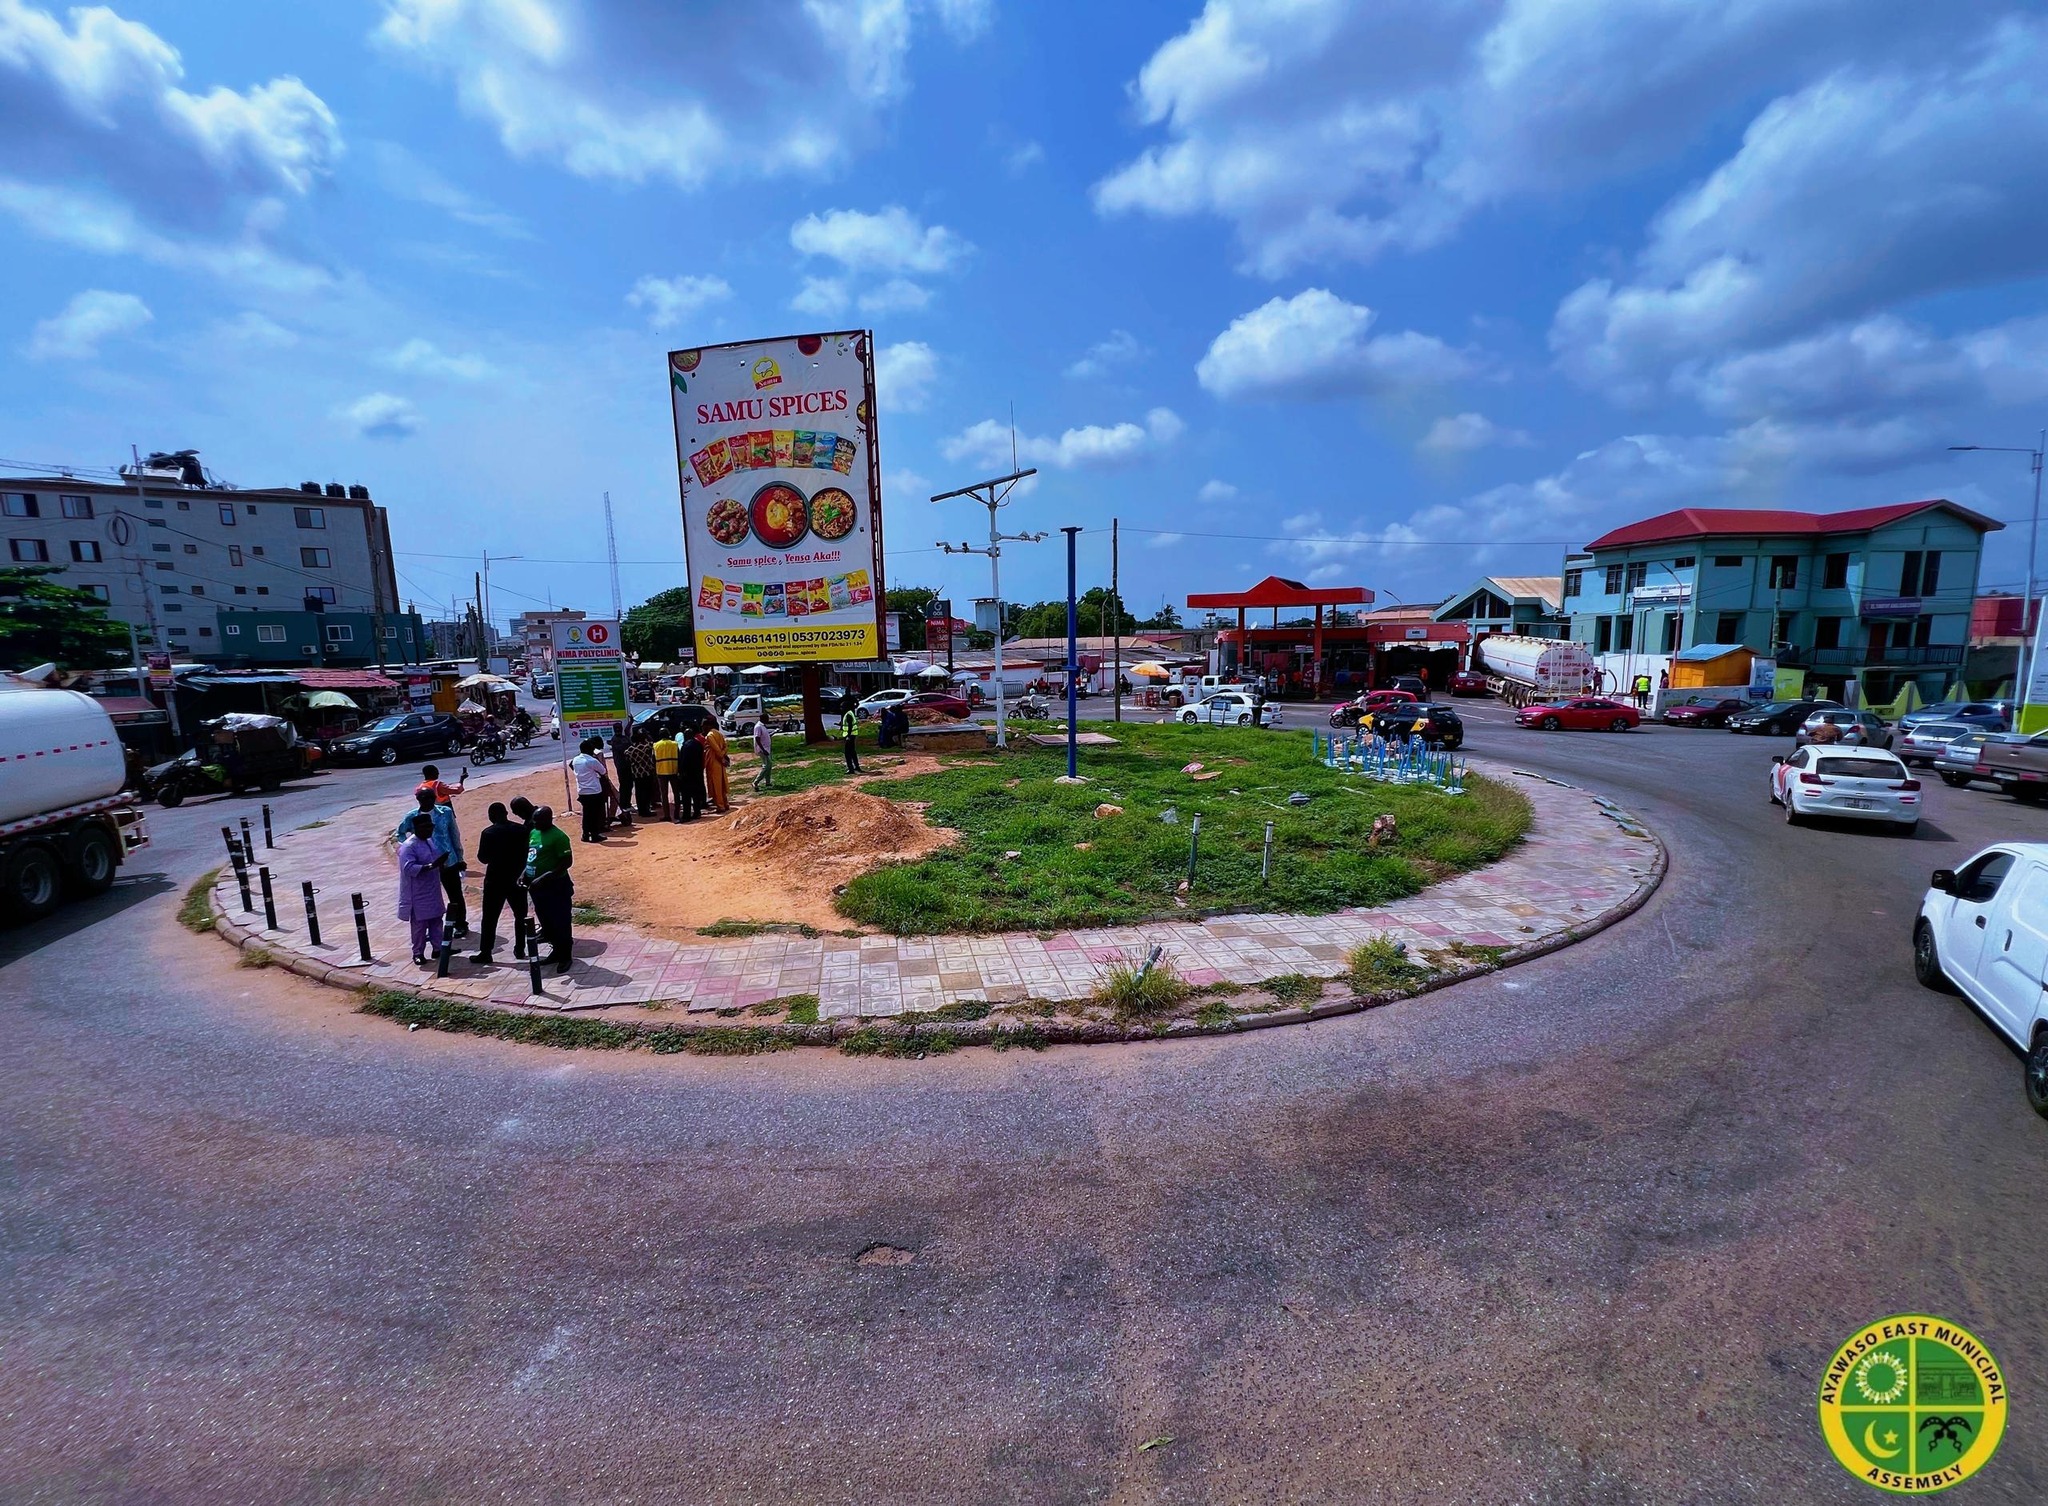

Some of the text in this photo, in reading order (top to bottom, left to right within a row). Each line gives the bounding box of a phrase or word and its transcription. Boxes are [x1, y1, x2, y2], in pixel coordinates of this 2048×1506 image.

[697, 389, 848, 425] SAMU SPICES
[727, 557, 752, 566] Samu
[784, 553, 810, 562] Yensa
[813, 550, 841, 561] Aka!!!
[592, 629, 603, 640] H
[716, 630, 865, 645] 0244661419 0537023973
[557, 649, 619, 658] NIMA POLYCLINIC
